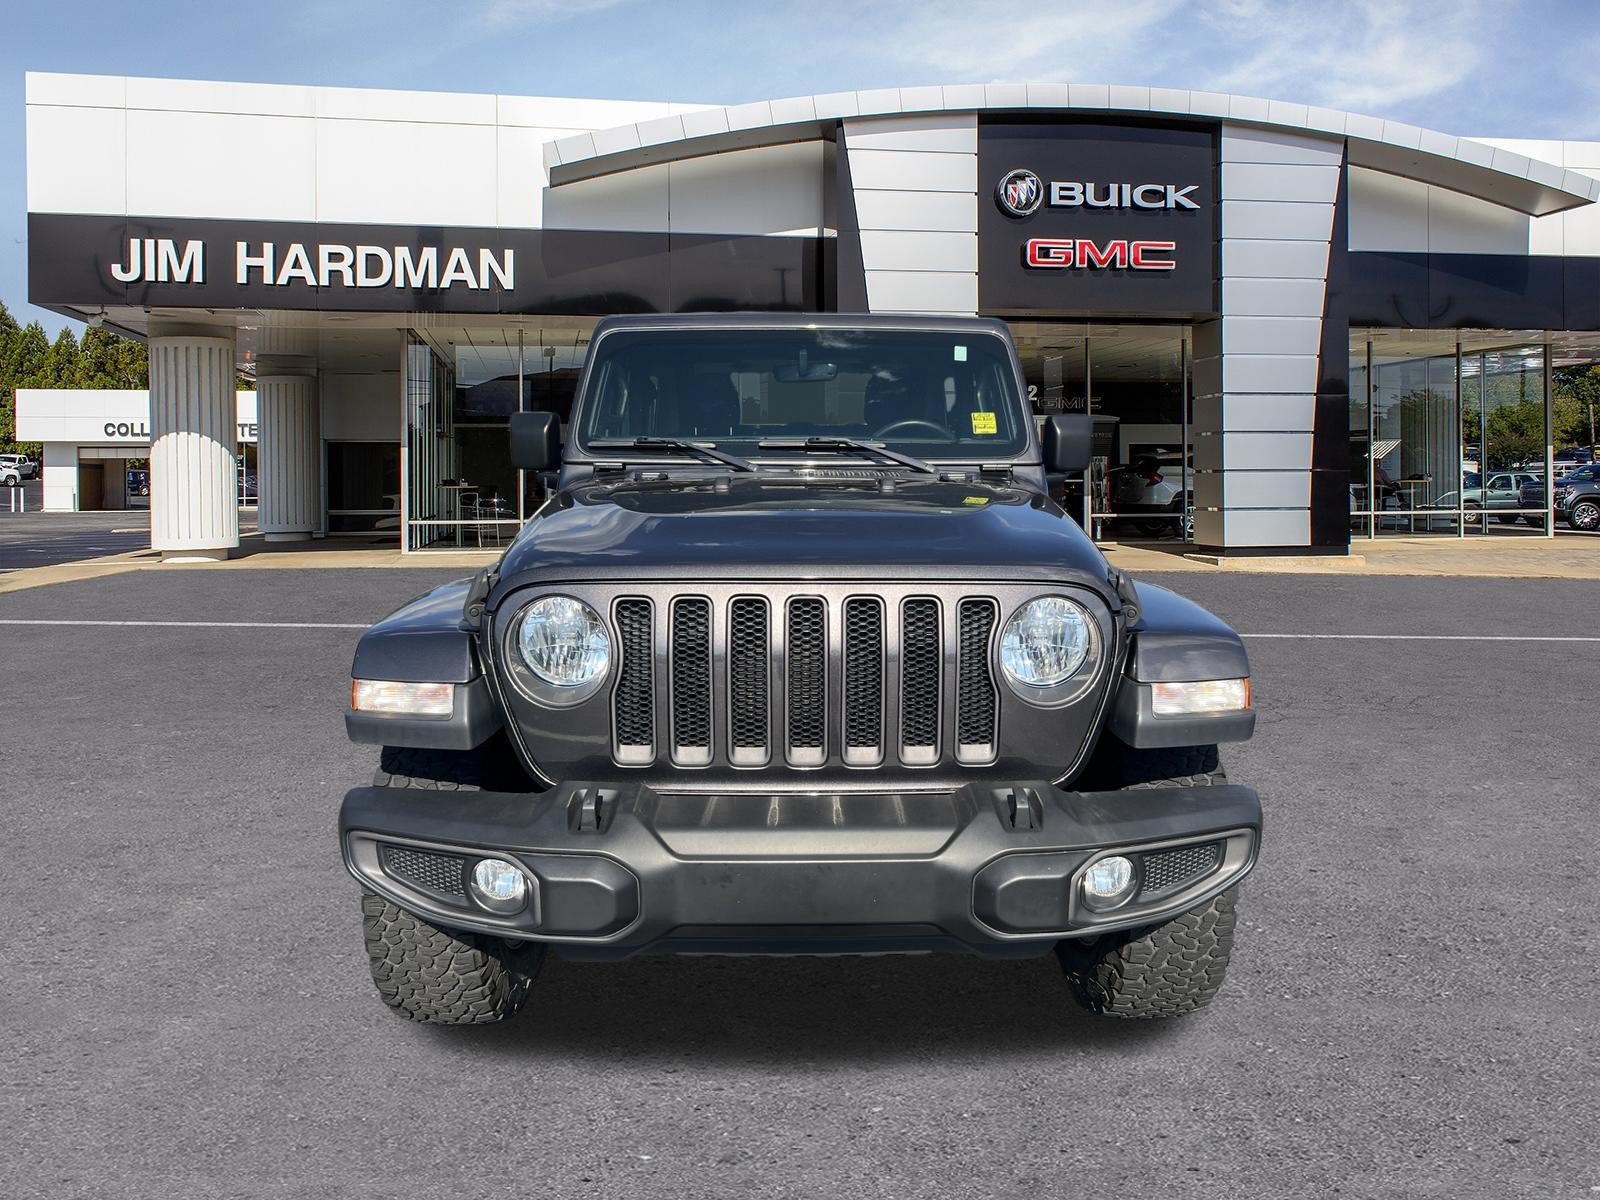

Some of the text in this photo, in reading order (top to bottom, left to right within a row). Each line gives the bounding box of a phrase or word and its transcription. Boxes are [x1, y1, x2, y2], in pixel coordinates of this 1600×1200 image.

[1050, 182, 1200, 209] BUICK
[111, 238, 515, 290] JIM HARDMAN
[1025, 238, 1176, 270] GMC
[1037, 396, 1102, 409] GMC
